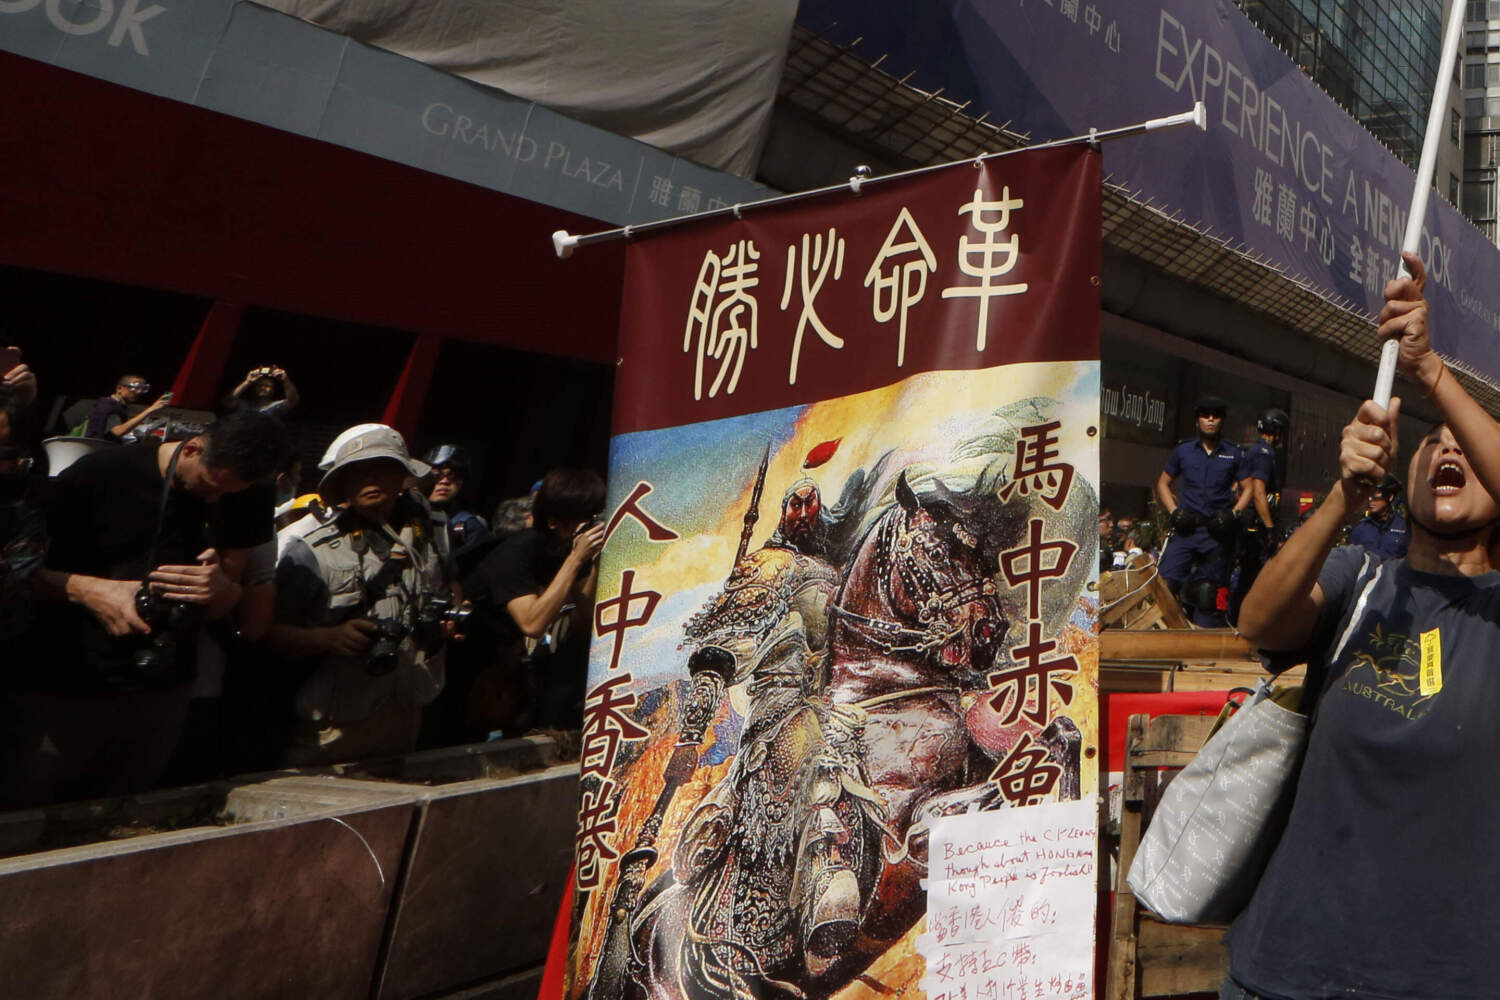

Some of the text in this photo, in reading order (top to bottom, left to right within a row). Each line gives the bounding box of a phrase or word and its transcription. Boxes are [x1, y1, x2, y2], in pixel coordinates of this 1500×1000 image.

[1155, 8, 1334, 205] EXPERIENCE
[1342, 169, 1359, 225] A
[421, 103, 623, 193] GRAND PLAZA
[1120, 384, 1144, 428] Sang
[1144, 389, 1165, 432] Sang
[948, 879, 976, 898] Kong
[1024, 868, 1037, 880] is
[994, 850, 1031, 869] about
